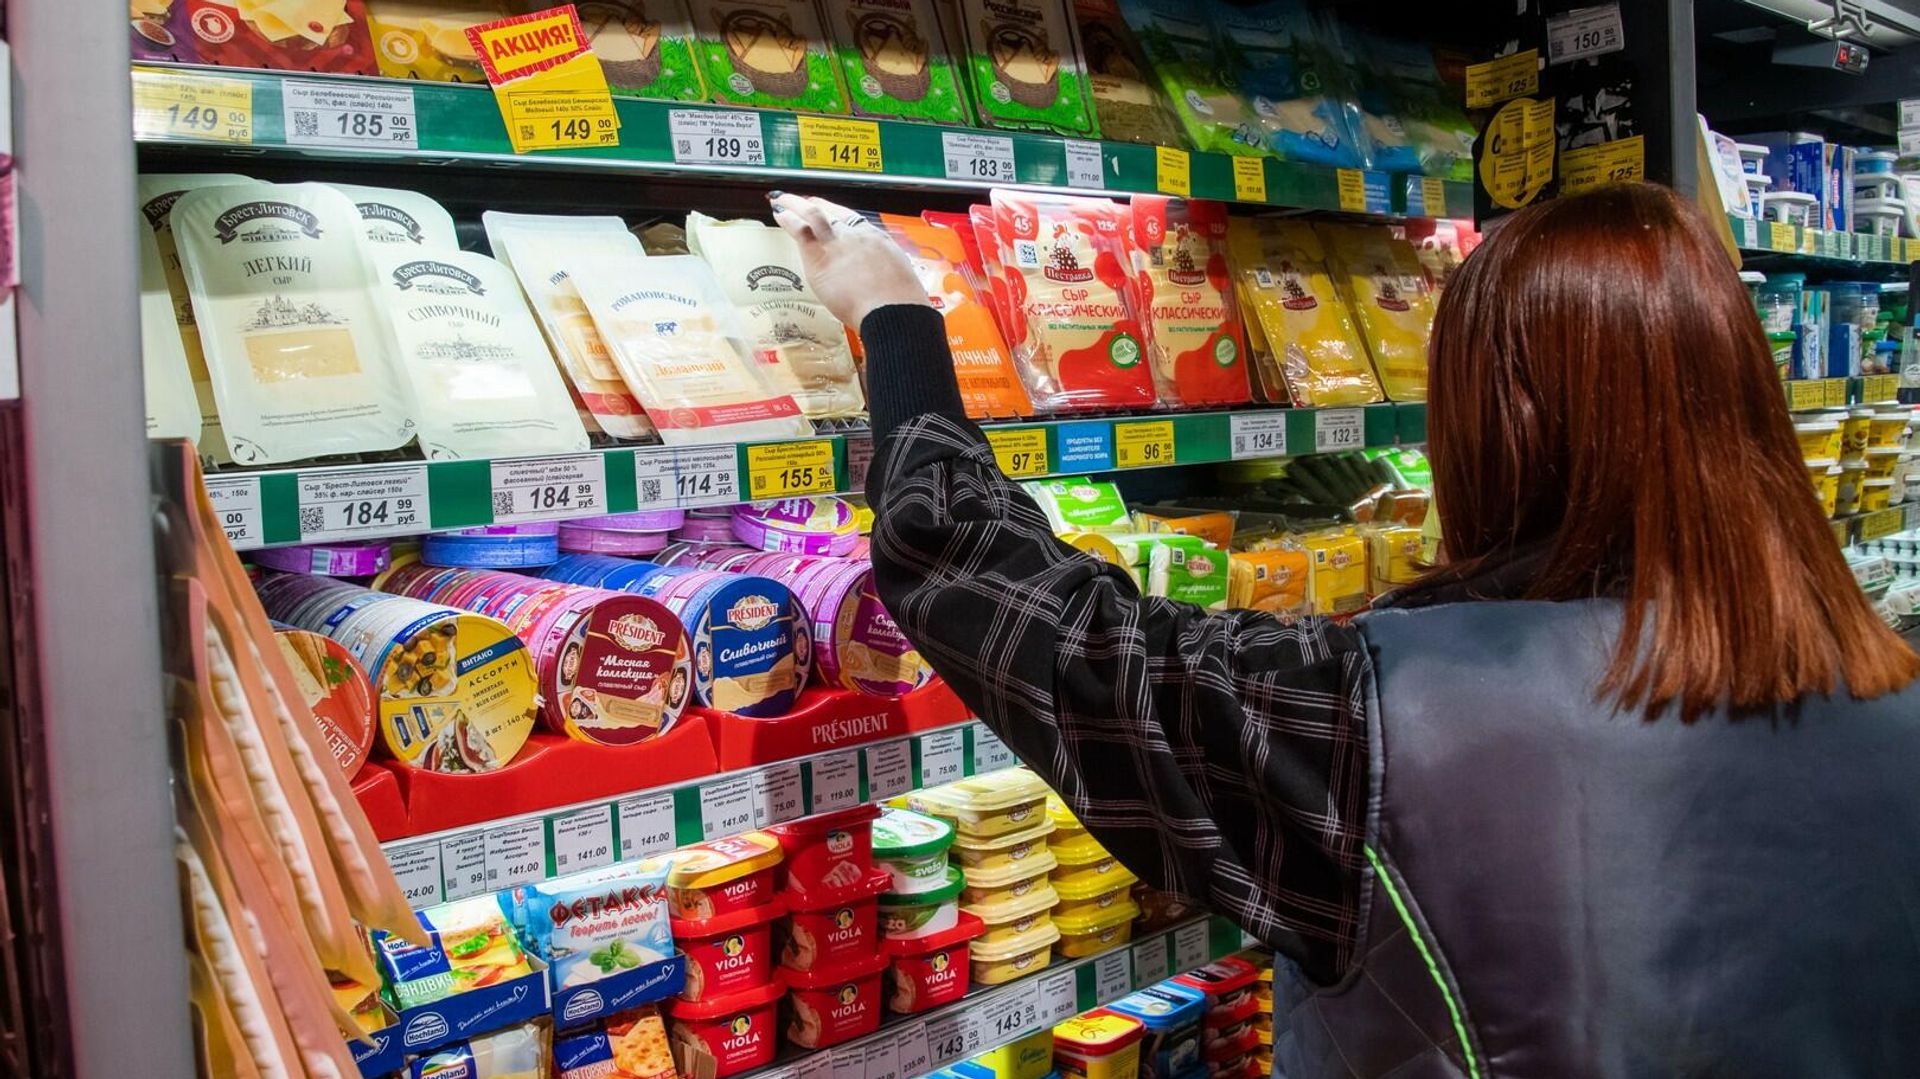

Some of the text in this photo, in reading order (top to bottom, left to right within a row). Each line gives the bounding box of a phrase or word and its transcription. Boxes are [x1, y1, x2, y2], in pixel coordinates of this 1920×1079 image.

[491, 23, 573, 60] АКЦИЯ!
[1574, 31, 1600, 50] 150
[1507, 78, 1527, 93] 125
[168, 104, 218, 131] 149
[229, 112, 246, 124] 00
[337, 113, 383, 137] 185
[392, 116, 407, 127] 00
[598, 119, 611, 128] 00
[229, 127, 248, 138] руб
[392, 131, 411, 142] руб
[551, 119, 591, 141] 149
[600, 133, 615, 143] руб
[705, 137, 741, 159] 189
[747, 139, 759, 149] 00
[748, 153, 762, 162] руб
[829, 144, 861, 164] 141
[867, 148, 878, 157] 00
[867, 160, 881, 168] руб
[970, 158, 997, 177] 183
[1002, 161, 1012, 170] 00
[1608, 166, 1634, 182] 125
[245, 255, 312, 278] ЛЕГКИЙ
[1046, 268, 1093, 282] Пестравка
[611, 290, 697, 312] РОМАНОВСКИЙ
[1062, 288, 1089, 301] СЫР
[1181, 291, 1201, 304] СЫР
[948, 335, 964, 346] ЫР
[1252, 433, 1273, 449] 134
[1332, 428, 1351, 443] 132
[1144, 443, 1160, 460] 96
[1012, 453, 1030, 471] 97
[718, 472, 730, 482] 99
[780, 467, 813, 489] 155
[304, 483, 321, 493] Сыр
[578, 484, 591, 494] 99
[676, 474, 711, 497] 114
[718, 486, 733, 496] руб
[397, 499, 413, 510] 99
[530, 486, 570, 510] 184
[578, 498, 594, 508] руб
[226, 512, 243, 524] 00
[343, 501, 389, 526] 184
[397, 514, 415, 525] руб
[608, 620, 665, 645] PRÉSIDENT
[720, 633, 787, 663] Сливочный
[461, 649, 493, 668] ВИТАКО
[469, 659, 518, 687] АССОРТИ
[507, 715, 520, 725] 140
[812, 712, 889, 745] PRÉSIDENT
[939, 764, 958, 774] 75.00
[886, 776, 906, 789] 75.00
[831, 788, 854, 801] 119.00
[774, 799, 796, 814] 75.00
[722, 813, 749, 828] 141.00
[641, 832, 670, 846] 141.00
[578, 846, 607, 861] 141.00
[508, 862, 539, 876] 141.00
[915, 860, 941, 878] sveža
[402, 885, 435, 899] 24.00
[724, 880, 758, 897] VIOLA
[550, 882, 669, 929] ФЕТАКСА
[570, 921, 618, 939] Творить
[828, 926, 862, 943] VIOLA
[715, 954, 753, 972] VIOLA
[394, 971, 455, 998] СЭНДВИЧ
[925, 969, 957, 985] VIOLA
[568, 1001, 600, 1017] Hochland
[832, 1002, 866, 1019] VIOLA
[1025, 1005, 1034, 1013] 00
[995, 1011, 1021, 1035] 143
[409, 1026, 445, 1042] Hochland
[723, 1032, 760, 1051] VIOLA
[968, 1030, 978, 1039] 00
[937, 1035, 964, 1060] 143
[903, 1055, 926, 1073] 235.00
